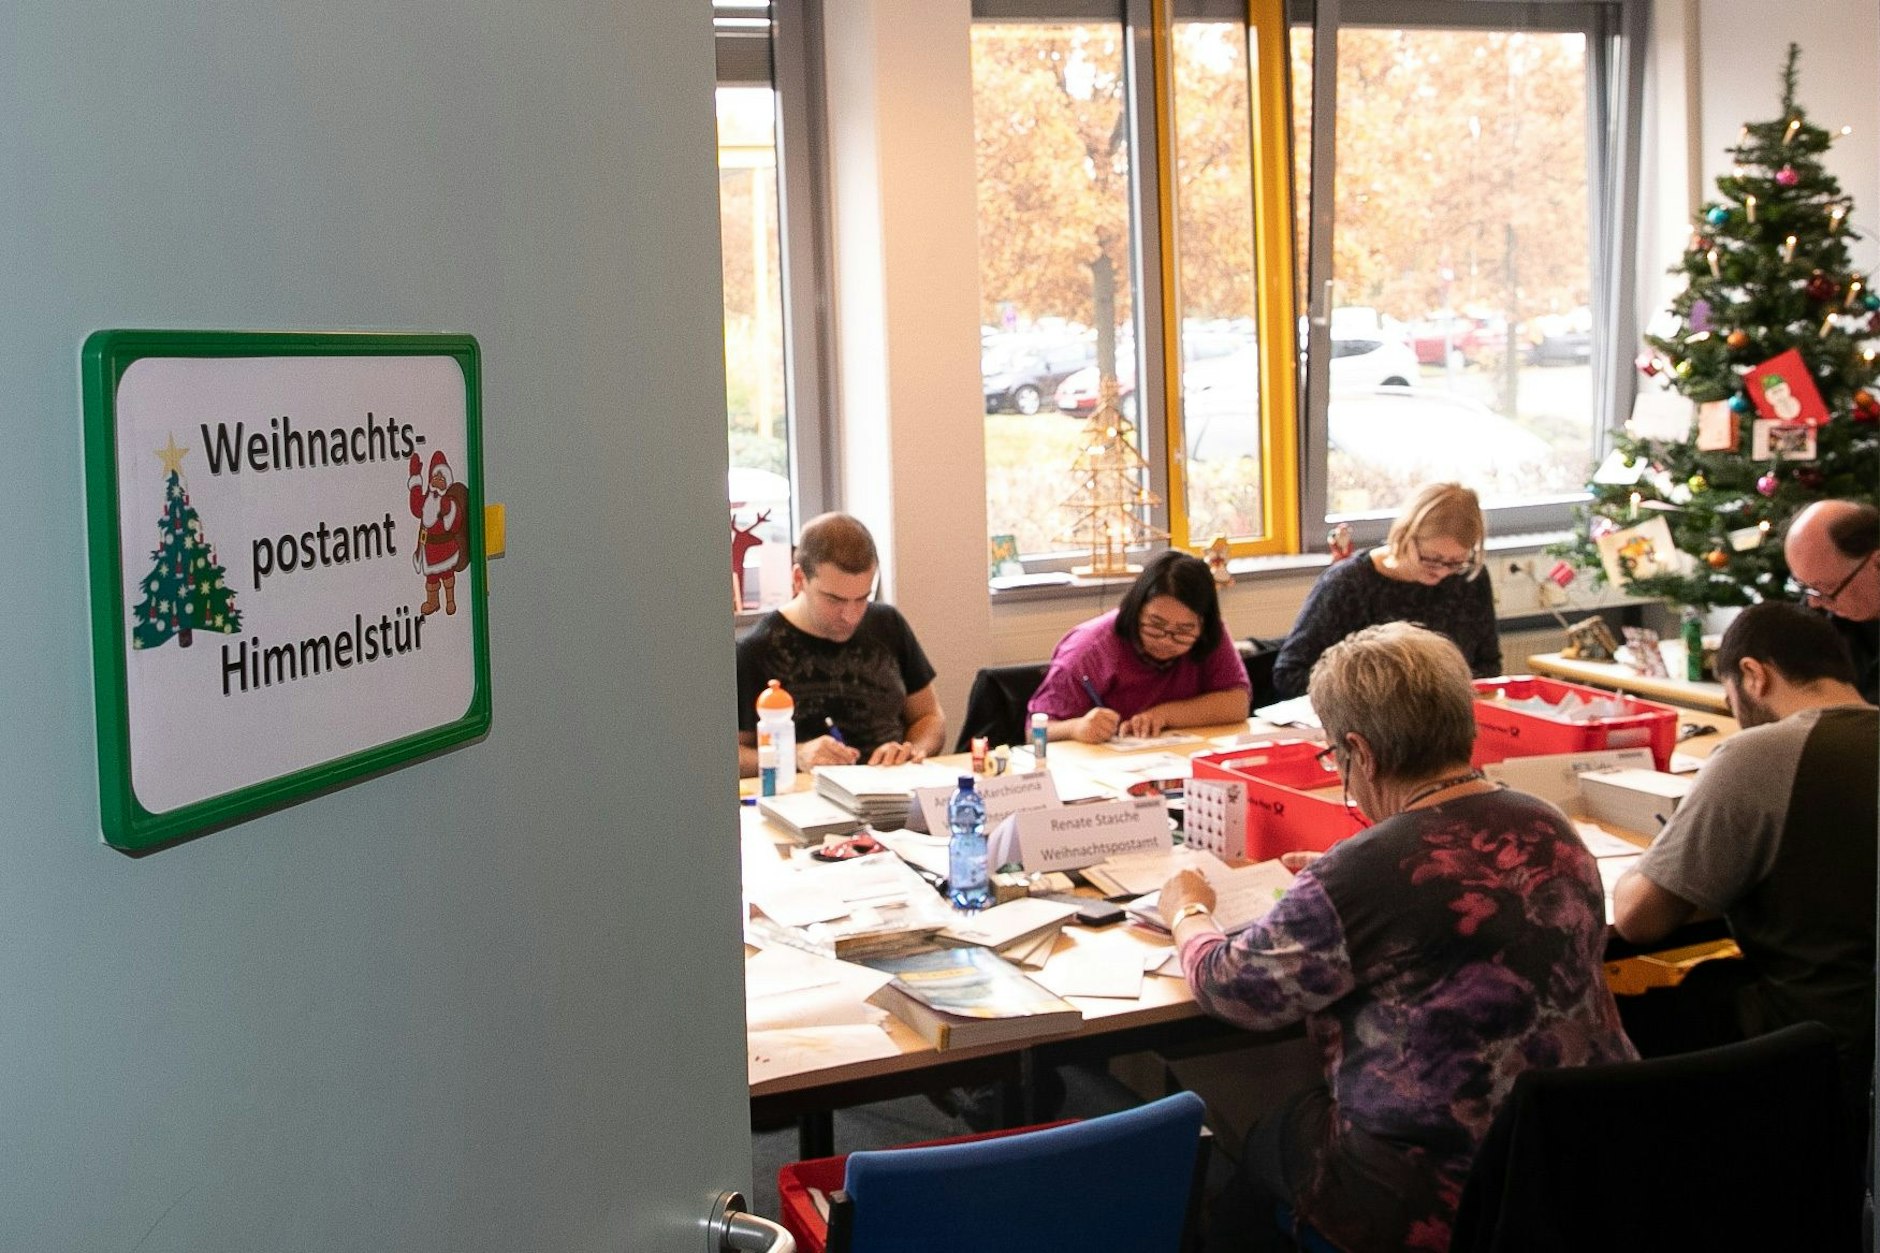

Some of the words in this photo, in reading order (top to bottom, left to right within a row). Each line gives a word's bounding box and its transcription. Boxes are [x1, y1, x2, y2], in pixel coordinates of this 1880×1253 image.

[200, 412, 427, 475] Weihnachts-
[251, 513, 397, 589] postamt
[220, 606, 426, 695] Himmelstür
[1040, 836, 1160, 861] Weihnachtspostamt
[1050, 815, 1093, 832] Renate
